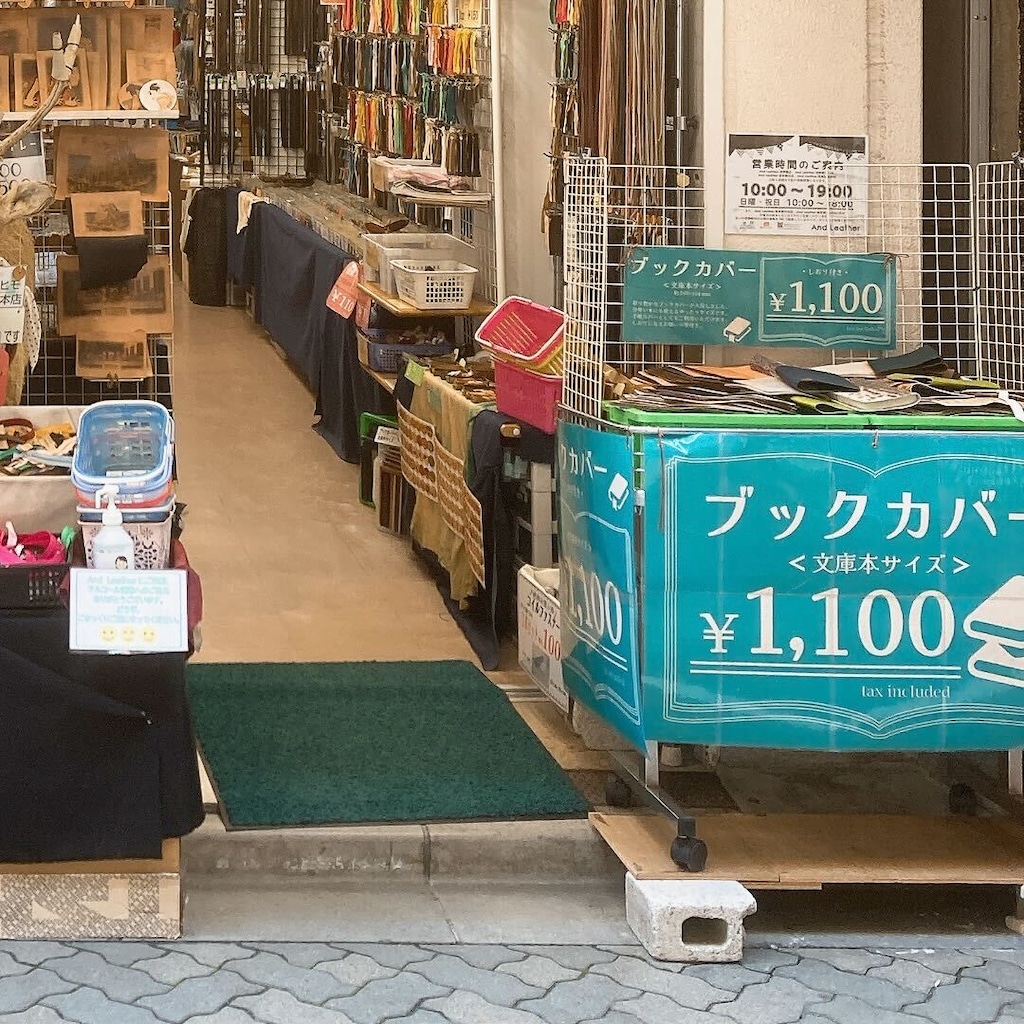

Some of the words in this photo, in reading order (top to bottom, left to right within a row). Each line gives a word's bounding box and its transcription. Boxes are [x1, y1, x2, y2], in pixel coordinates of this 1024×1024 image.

[752, 159, 844, 170] 営業時間のご案内
[811, 224, 828, 232] And
[631, 256, 756, 277] ブックカバー
[769, 280, 883, 316] ¥1,100
[699, 587, 956, 663] ¥1,100
[861, 686, 882, 699] tax
[886, 685, 951, 700] included
